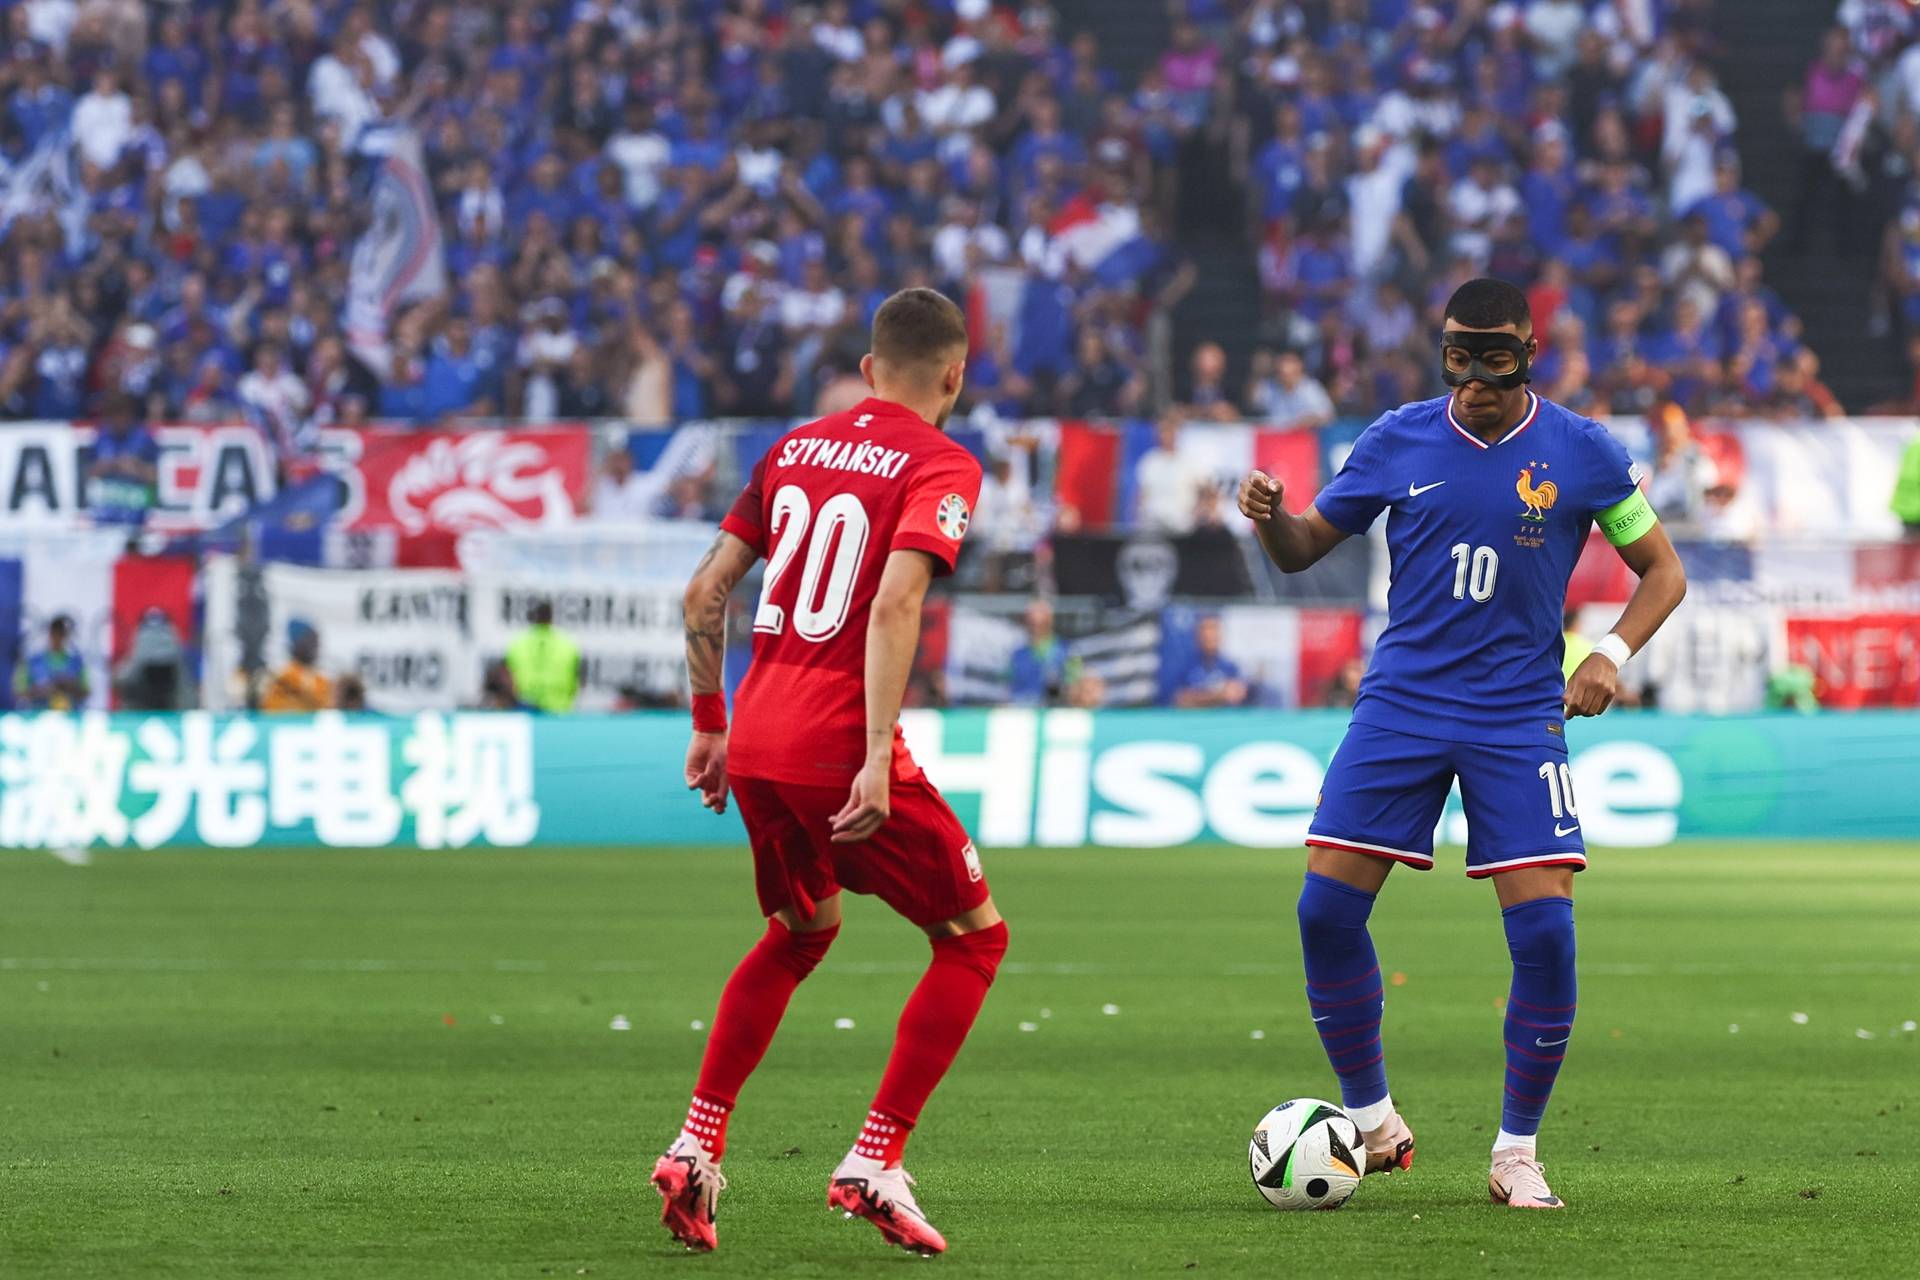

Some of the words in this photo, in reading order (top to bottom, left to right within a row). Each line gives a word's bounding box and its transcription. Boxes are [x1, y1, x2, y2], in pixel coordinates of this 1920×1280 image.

[777, 439, 909, 479] SZYMAŃSKI
[1615, 502, 1646, 530] RESPECT
[753, 485, 870, 643] 20
[1451, 543, 1499, 603] 10
[0, 710, 541, 849] 激光电视
[902, 708, 1683, 848] Hisee
[1538, 762, 1577, 818] 10
